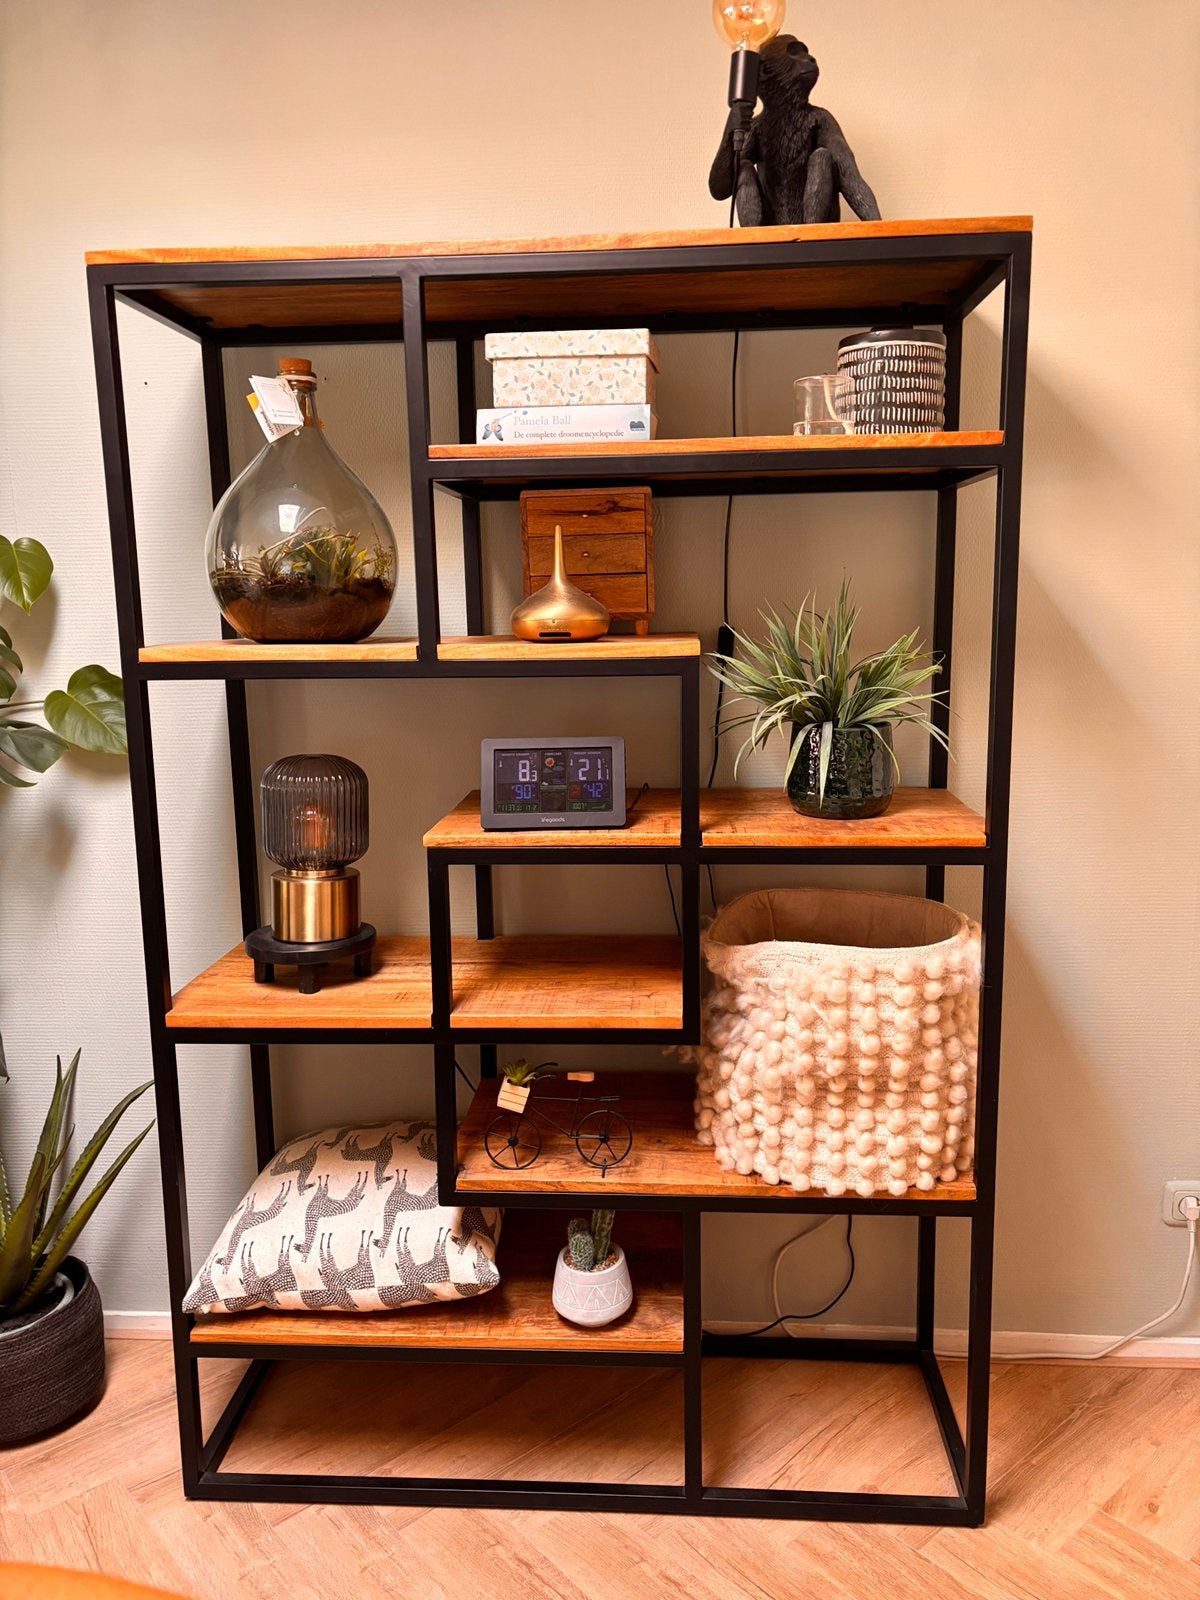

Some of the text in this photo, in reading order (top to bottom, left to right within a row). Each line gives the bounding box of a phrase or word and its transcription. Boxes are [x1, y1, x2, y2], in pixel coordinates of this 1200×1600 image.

[513, 415, 572, 426] Pamela Ball
[513, 429, 625, 440] De complete droomencyclopedie
